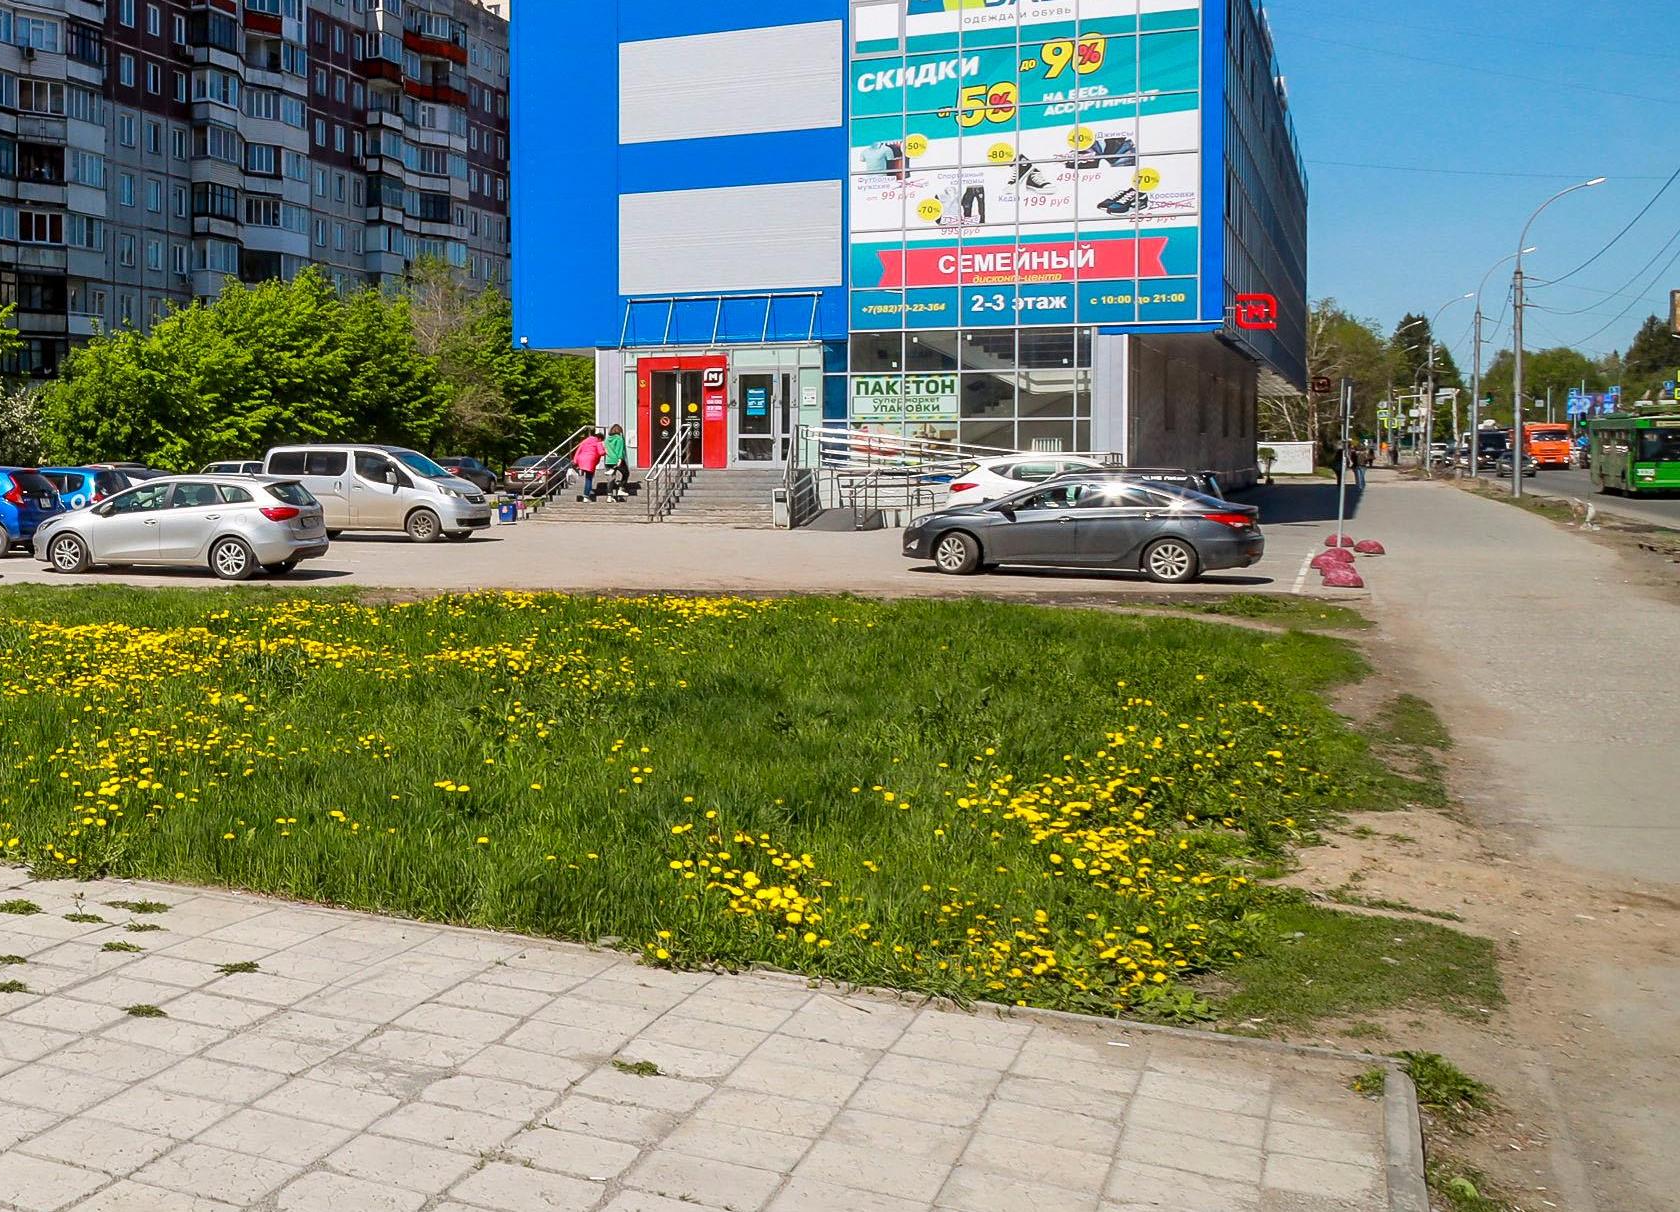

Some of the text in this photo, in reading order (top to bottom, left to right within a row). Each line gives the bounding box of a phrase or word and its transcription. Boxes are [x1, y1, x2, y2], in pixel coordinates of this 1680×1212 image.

[963, 13, 1015, 24] ОДЕЖДА
[1031, 7, 1072, 17] ОБУВЬ
[857, 56, 980, 93] СКИДКИ
[1042, 84, 1109, 102] НА ВЕСЬ
[1042, 89, 1161, 117] АССОРТИМЕНТ
[1081, 171, 1102, 183] руб
[881, 190, 897, 201] 99
[1022, 195, 1047, 207] 199
[1050, 195, 1071, 207] руб
[937, 244, 1095, 275] СЕМЕЙНЫЙ
[971, 271, 1063, 284] дисконт-центр
[970, 294, 1068, 312] 2-3 этаж
[1100, 295, 1132, 305] 10:00
[1134, 295, 1150, 306] до
[1152, 293, 1186, 304] 21:00
[855, 379, 955, 396] ПАКЕТОН
[871, 396, 941, 405] супермаркет
[872, 403, 941, 414] УПАКОВКИ
